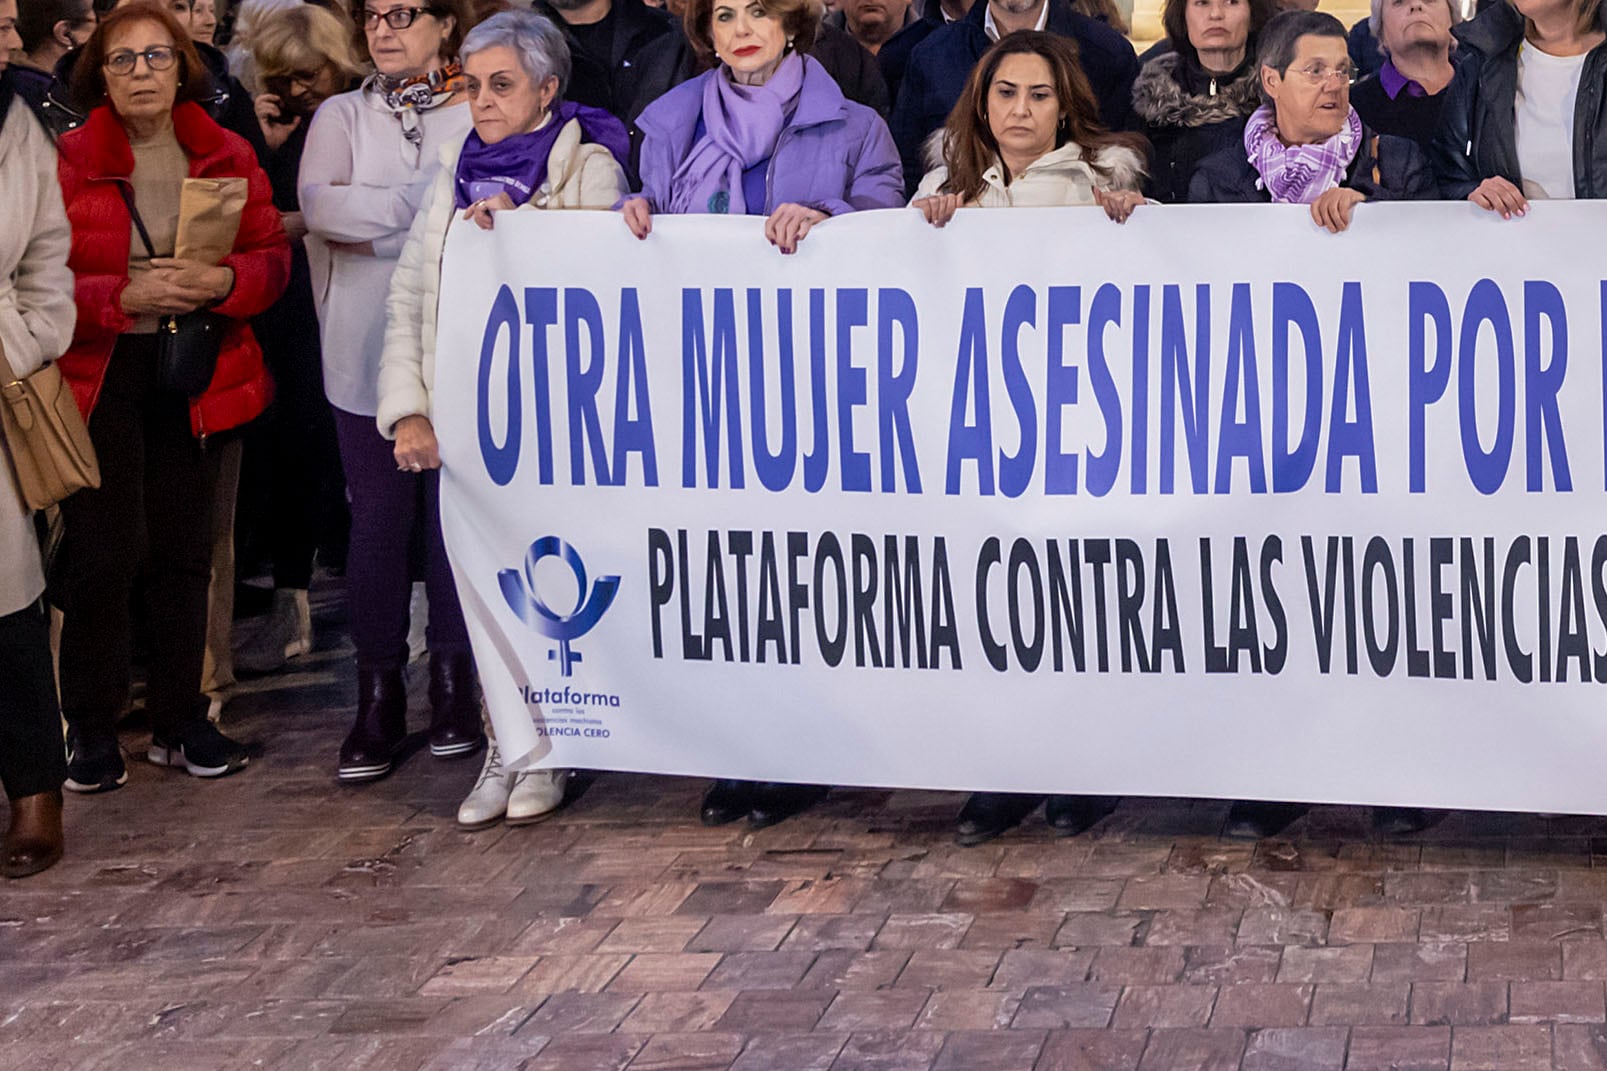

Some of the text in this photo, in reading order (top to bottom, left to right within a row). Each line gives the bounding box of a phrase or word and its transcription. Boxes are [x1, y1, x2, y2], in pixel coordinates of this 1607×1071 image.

[478, 283, 658, 487] OTRA
[682, 287, 923, 494] MUJER
[945, 282, 1378, 498] ASESINADA
[1408, 278, 1574, 496] POR
[647, 527, 963, 671] PLATAFORMA
[975, 536, 1186, 674] CONTRA
[1199, 534, 1288, 676] LAS
[536, 727, 611, 739] OLENCIA CERO
